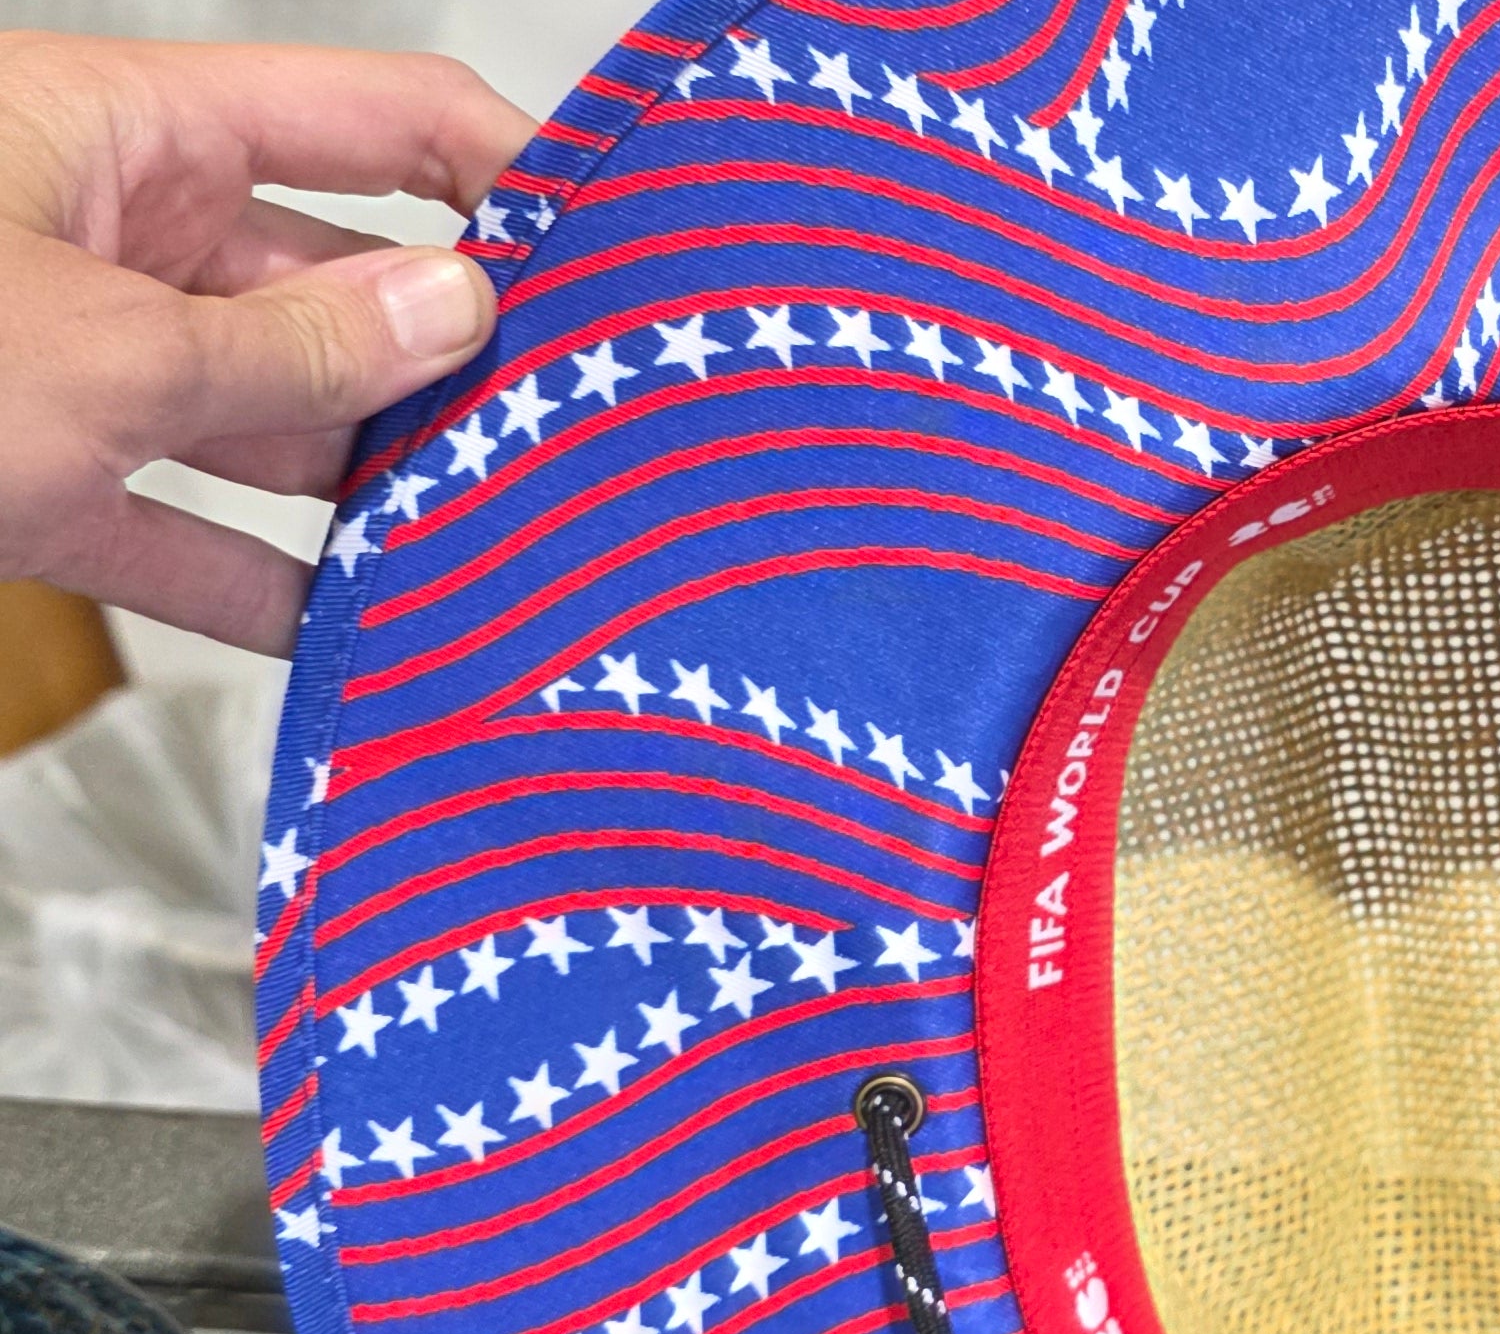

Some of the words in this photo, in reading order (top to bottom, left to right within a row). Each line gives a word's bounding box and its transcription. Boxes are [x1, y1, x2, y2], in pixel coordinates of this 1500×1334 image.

[1129, 559, 1204, 645] CUP
[1041, 668, 1124, 857] WORLD
[1027, 870, 1068, 991] FIFA
